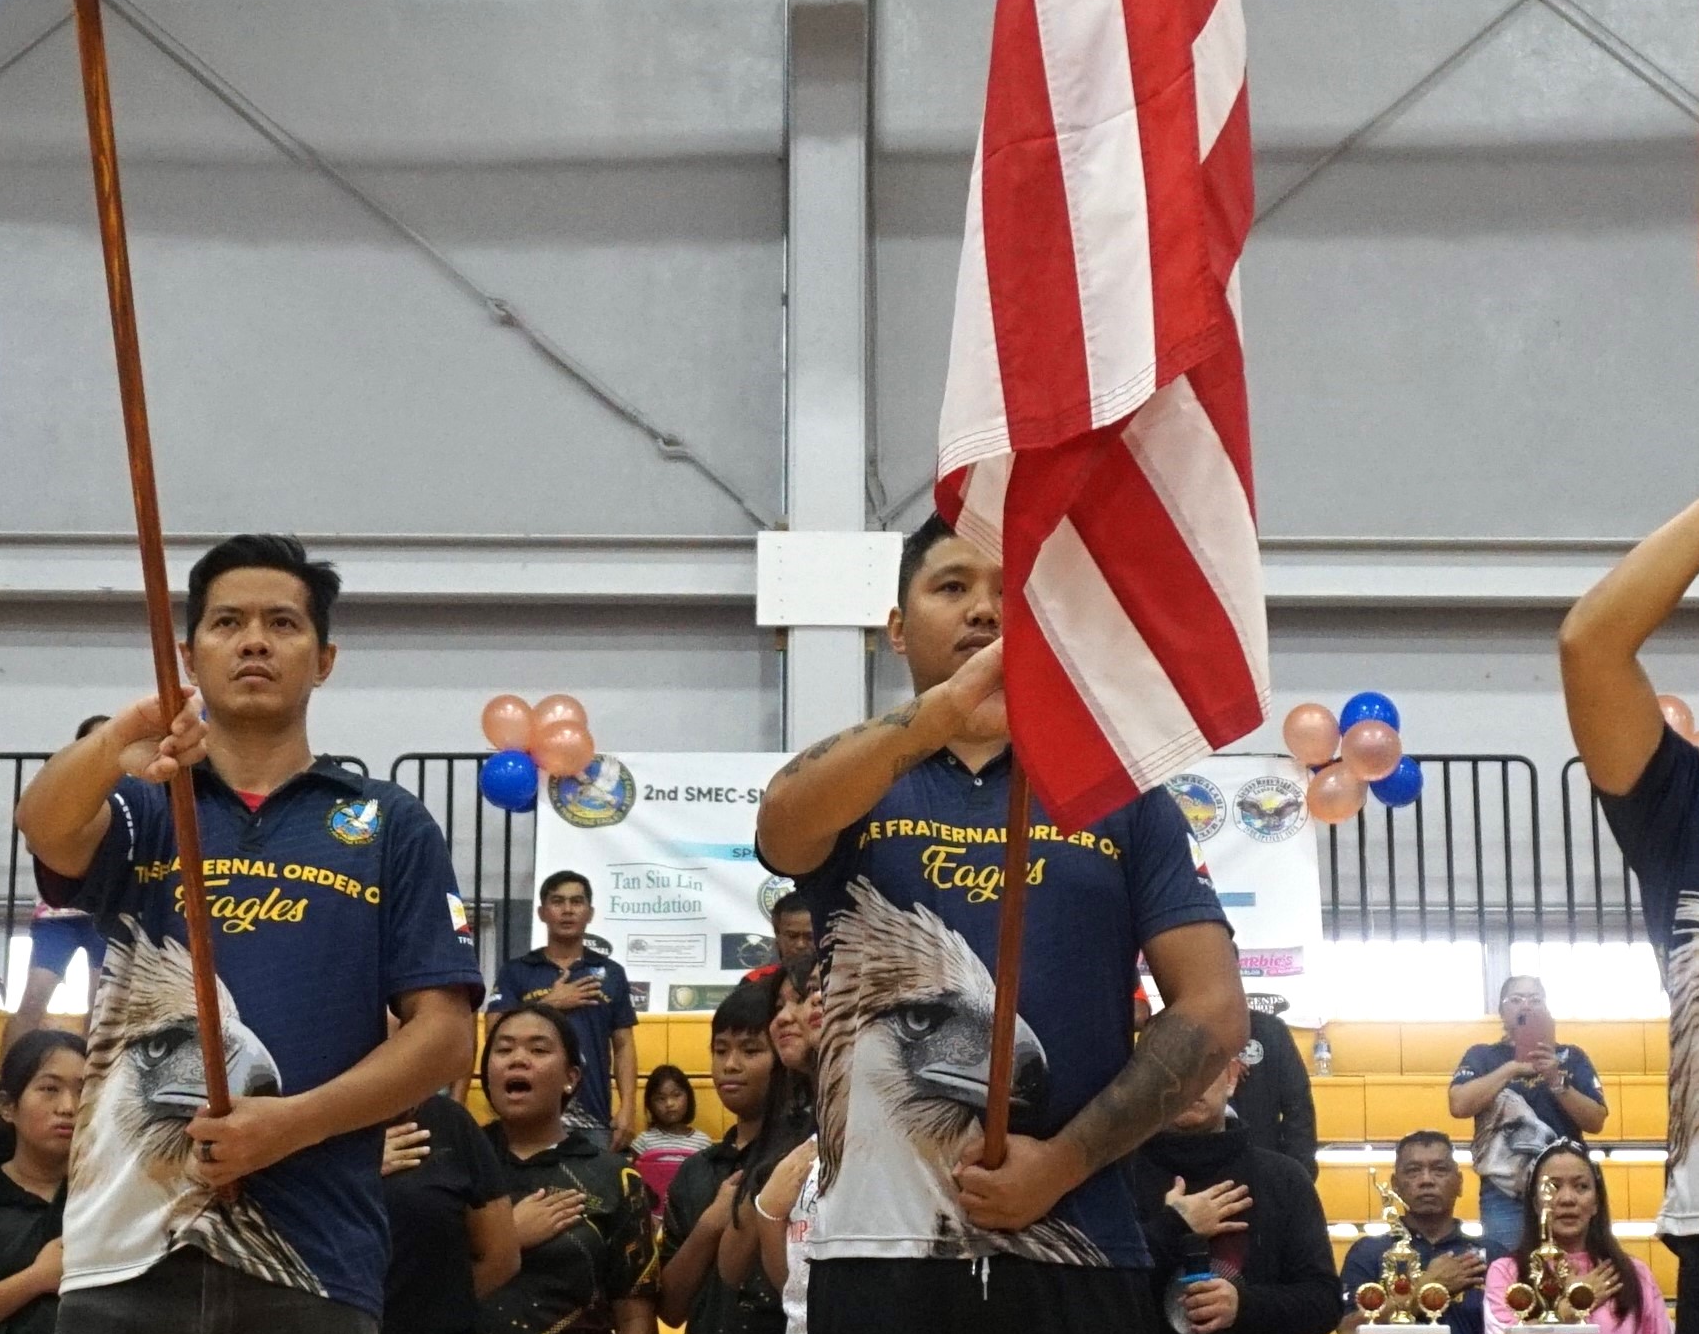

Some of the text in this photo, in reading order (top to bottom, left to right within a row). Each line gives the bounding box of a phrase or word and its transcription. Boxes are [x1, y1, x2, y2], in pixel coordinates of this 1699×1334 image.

[643, 785, 678, 802] 2nd
[283, 864, 361, 900] ORDER
[610, 870, 703, 892] Tan Siu Lin
[610, 895, 703, 915] Foundation
